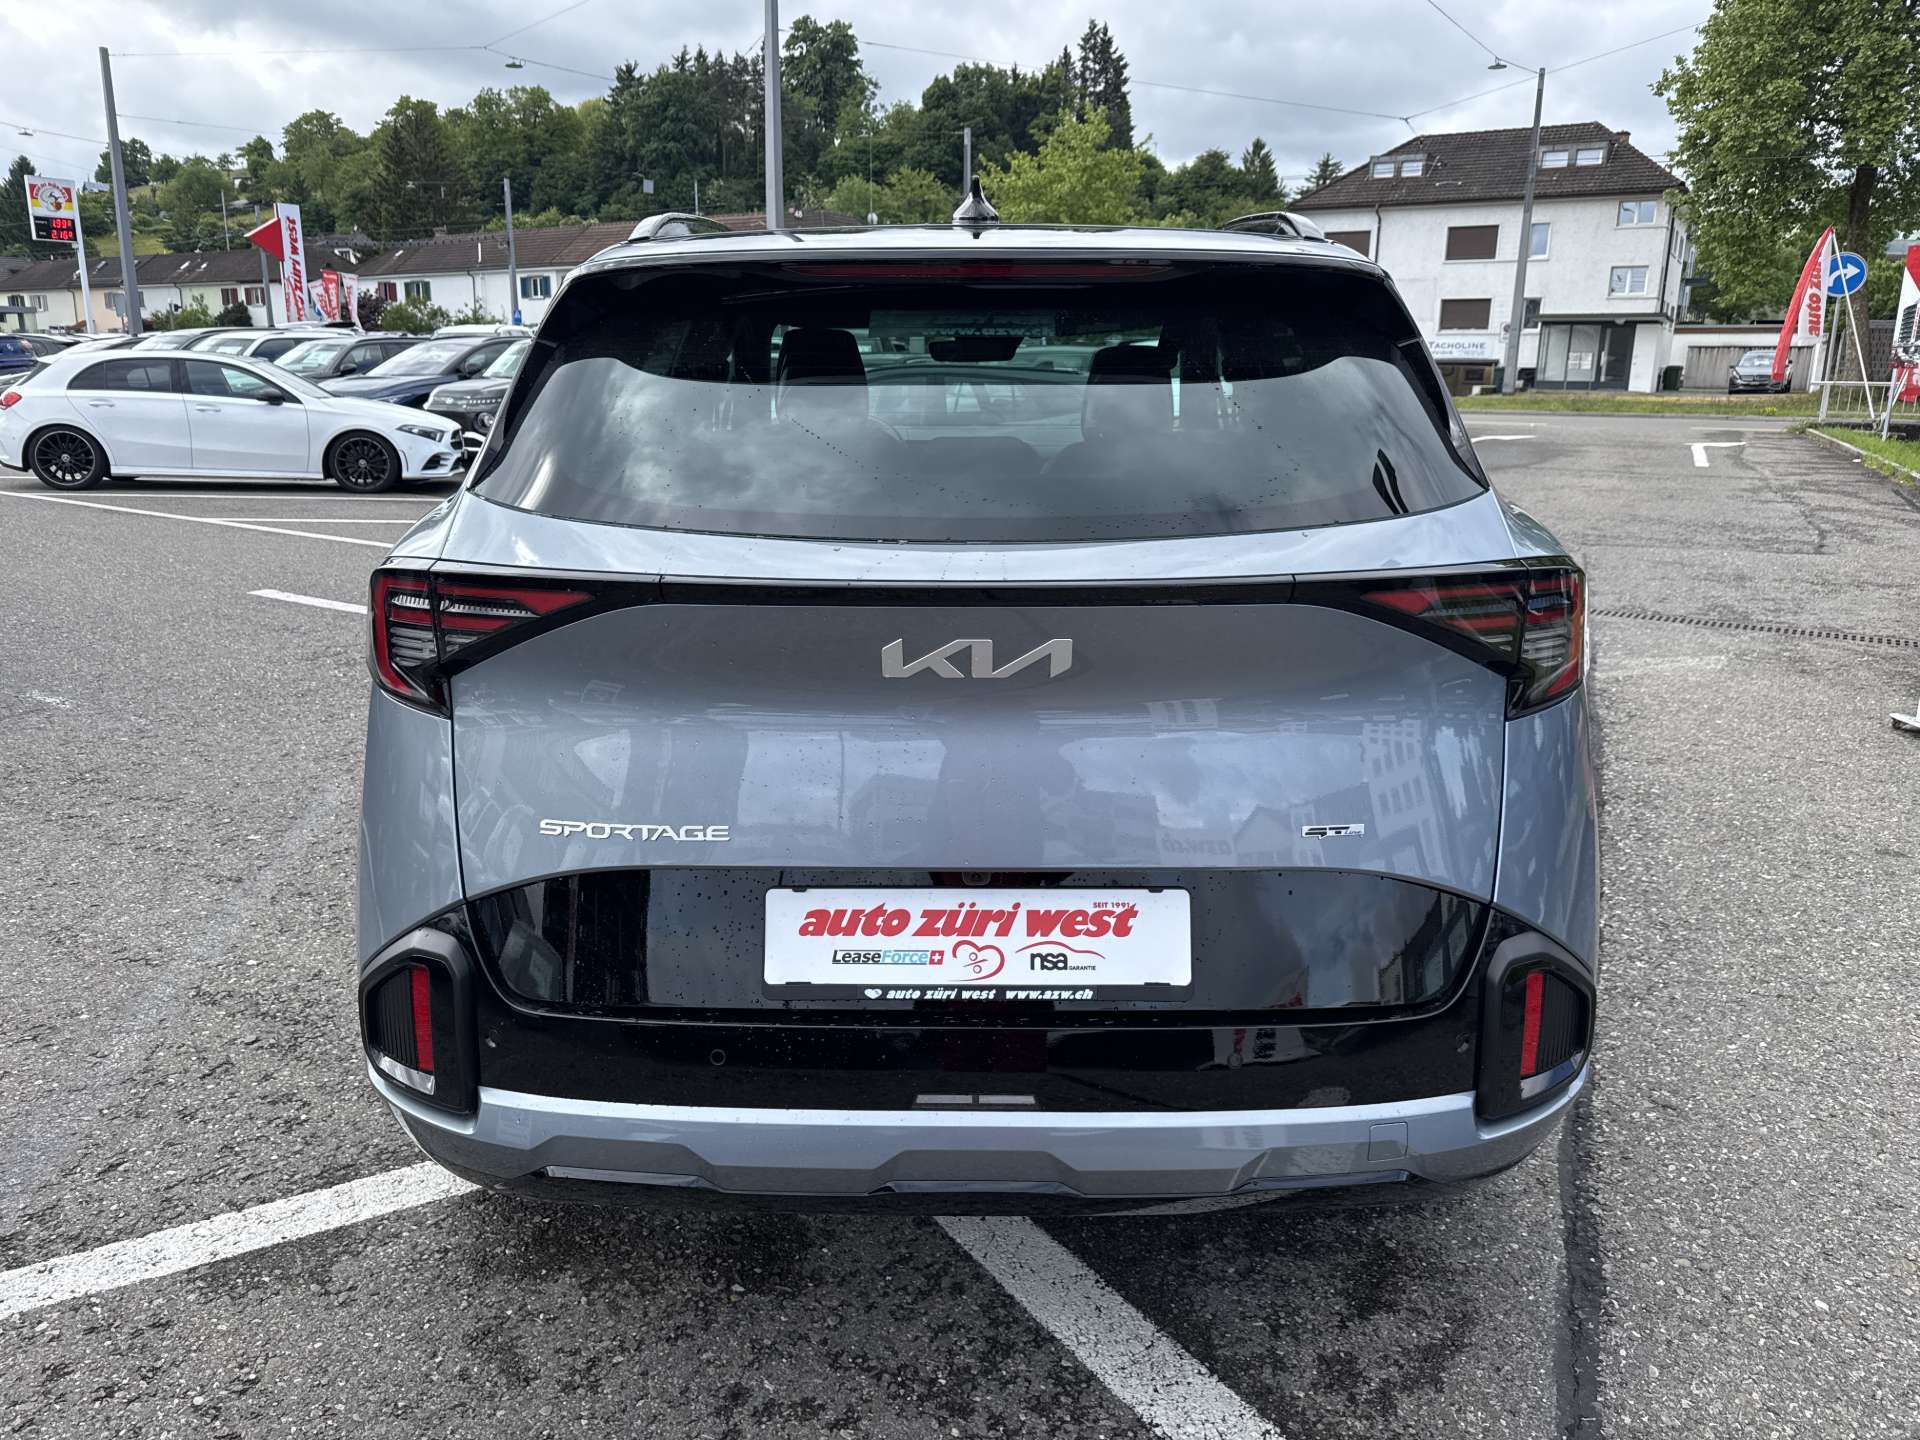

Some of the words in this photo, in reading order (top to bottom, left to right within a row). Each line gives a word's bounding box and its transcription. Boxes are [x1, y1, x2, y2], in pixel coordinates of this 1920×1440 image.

[286, 216, 299, 256] west
[1805, 293, 1822, 337] auto
[1428, 341, 1487, 350] TACHOLINE
[881, 638, 1074, 679] KIA
[538, 818, 730, 843] SPORTAGE
[799, 903, 911, 937] auto
[912, 902, 1021, 938] züri
[1026, 903, 1138, 938] west
[832, 949, 929, 965] LeaseForce
[1030, 952, 1068, 971] nsa
[886, 988, 921, 999] auto
[924, 988, 956, 999] züri
[958, 988, 996, 999] west
[1005, 988, 1094, 999] www.azw.ch
